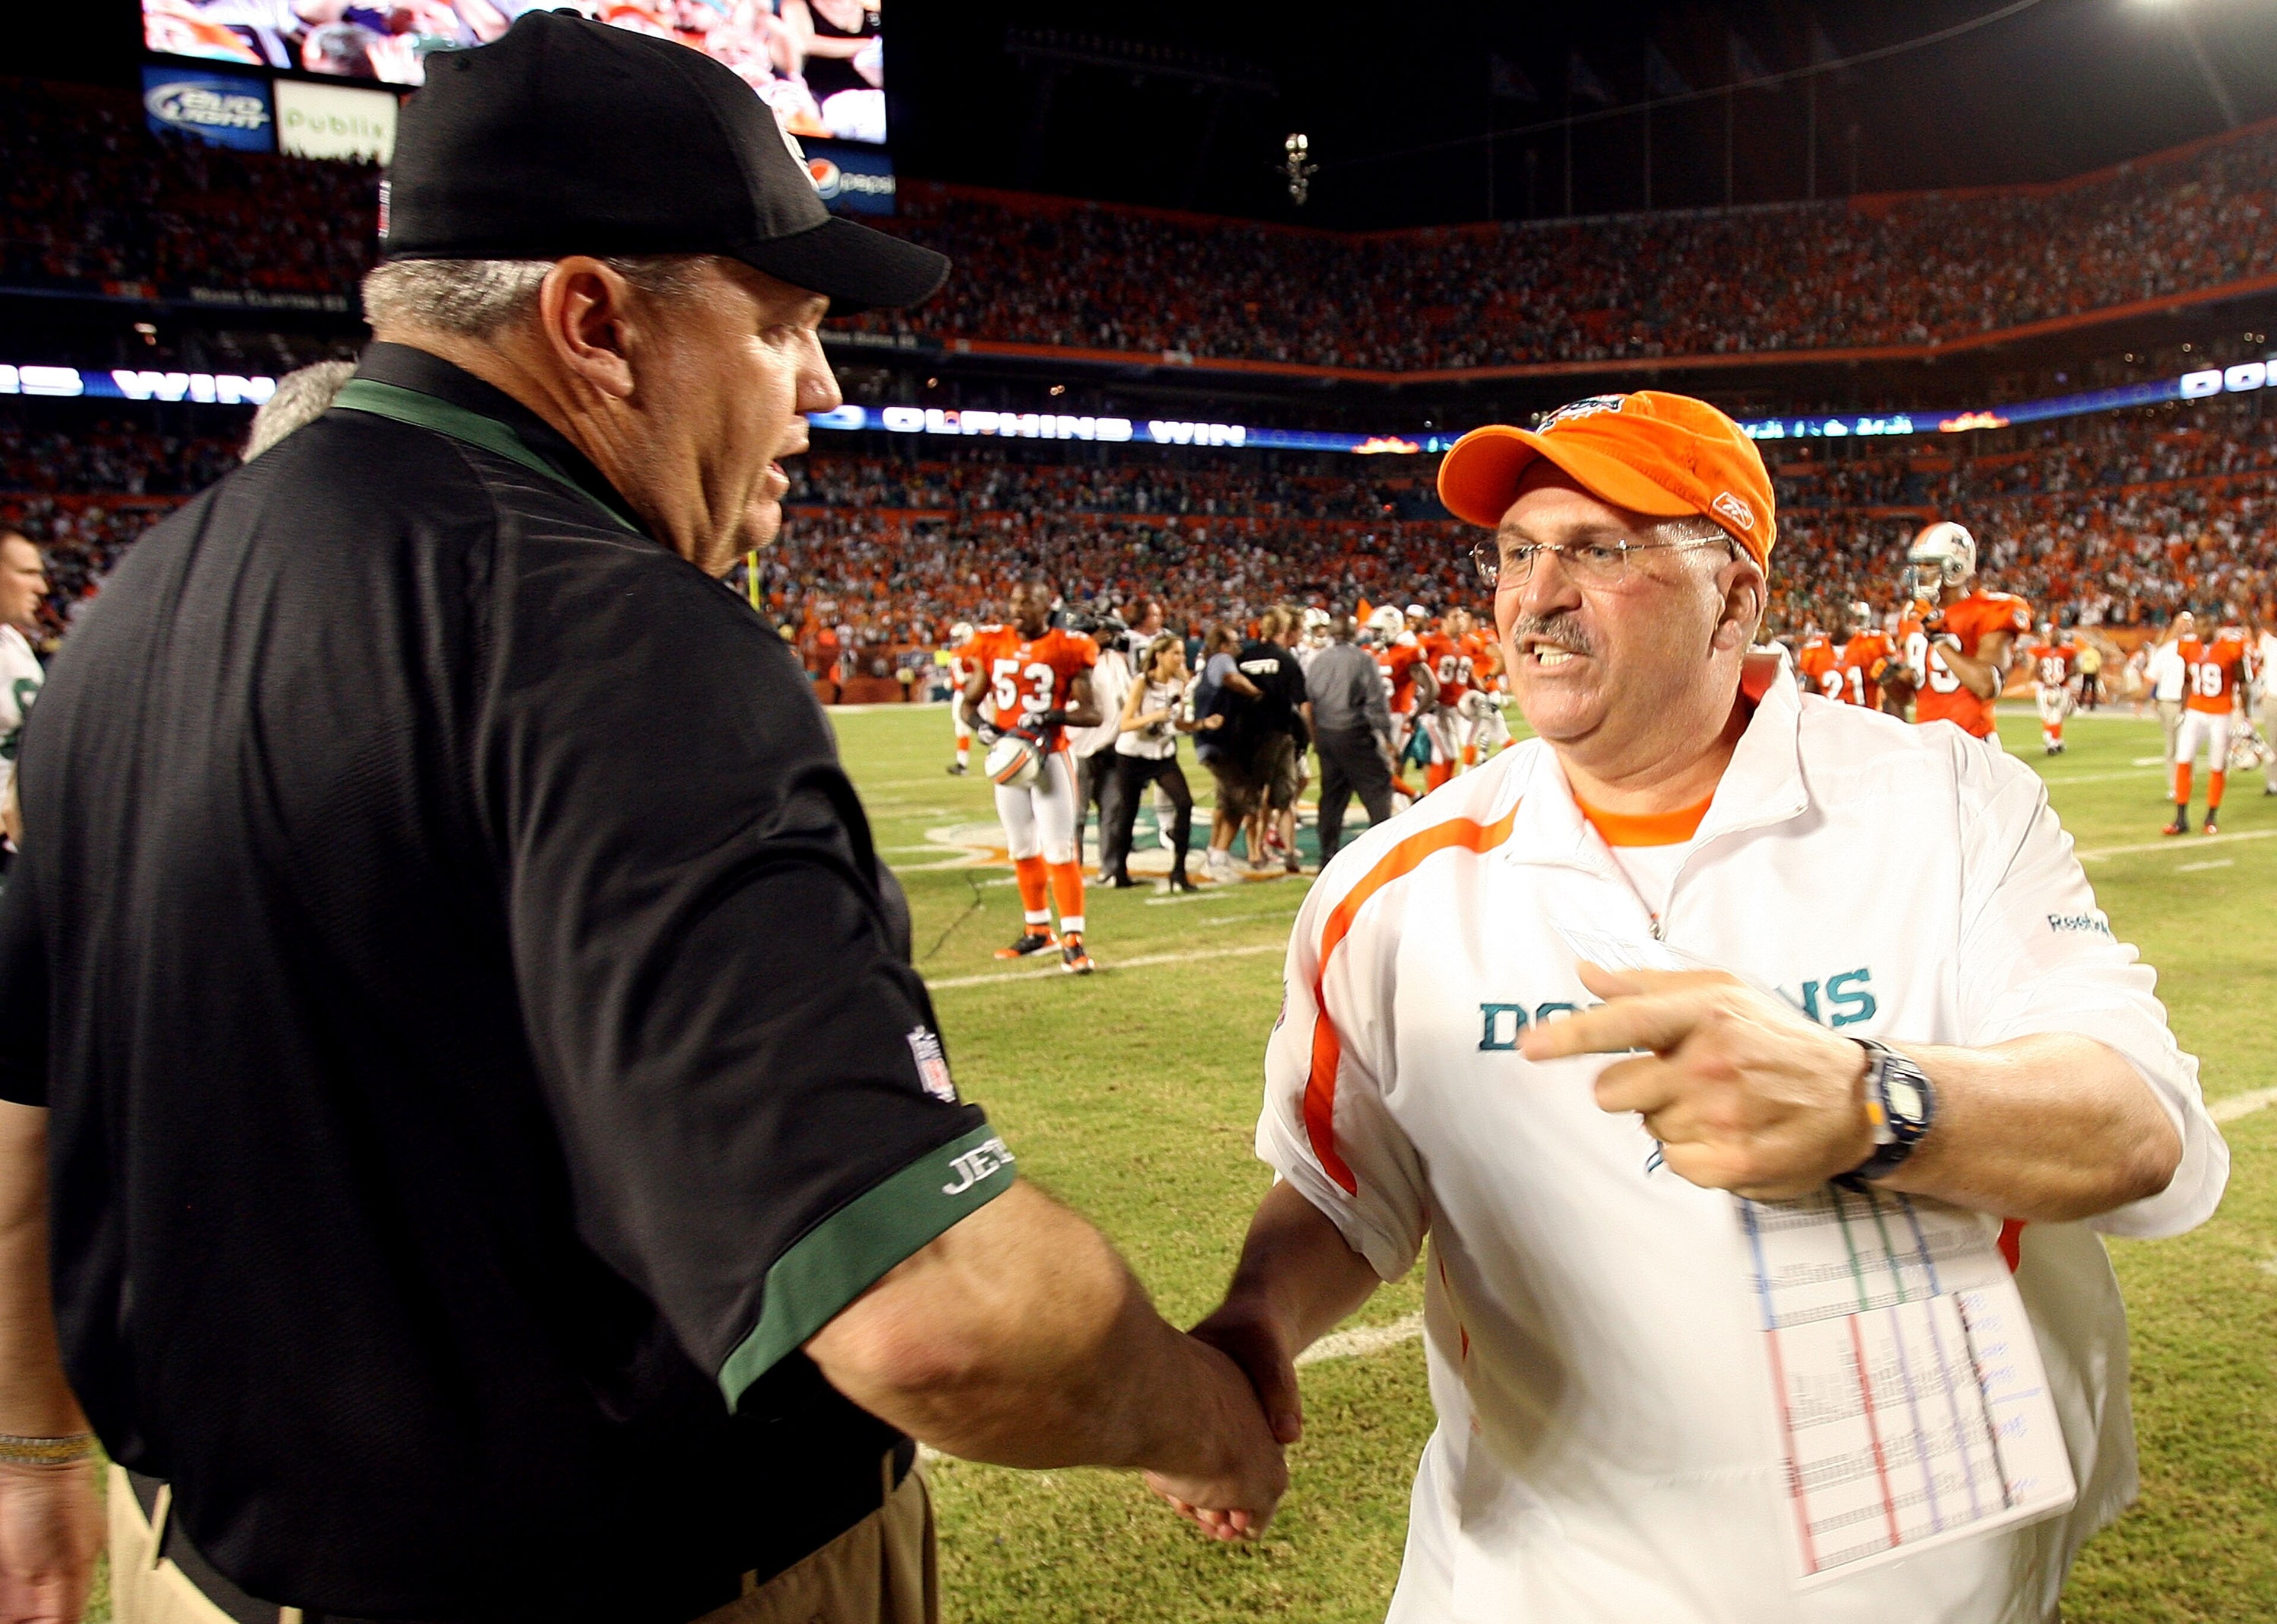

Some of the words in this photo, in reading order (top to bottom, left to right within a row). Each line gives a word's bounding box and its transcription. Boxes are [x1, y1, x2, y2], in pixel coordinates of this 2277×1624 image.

[285, 107, 384, 138] Publix
[111, 370, 276, 406] WIN
[1148, 420, 1247, 447] WIN
[1239, 658, 1280, 675] ESPN
[992, 658, 1054, 713] 53
[1822, 665, 1865, 706] 21
